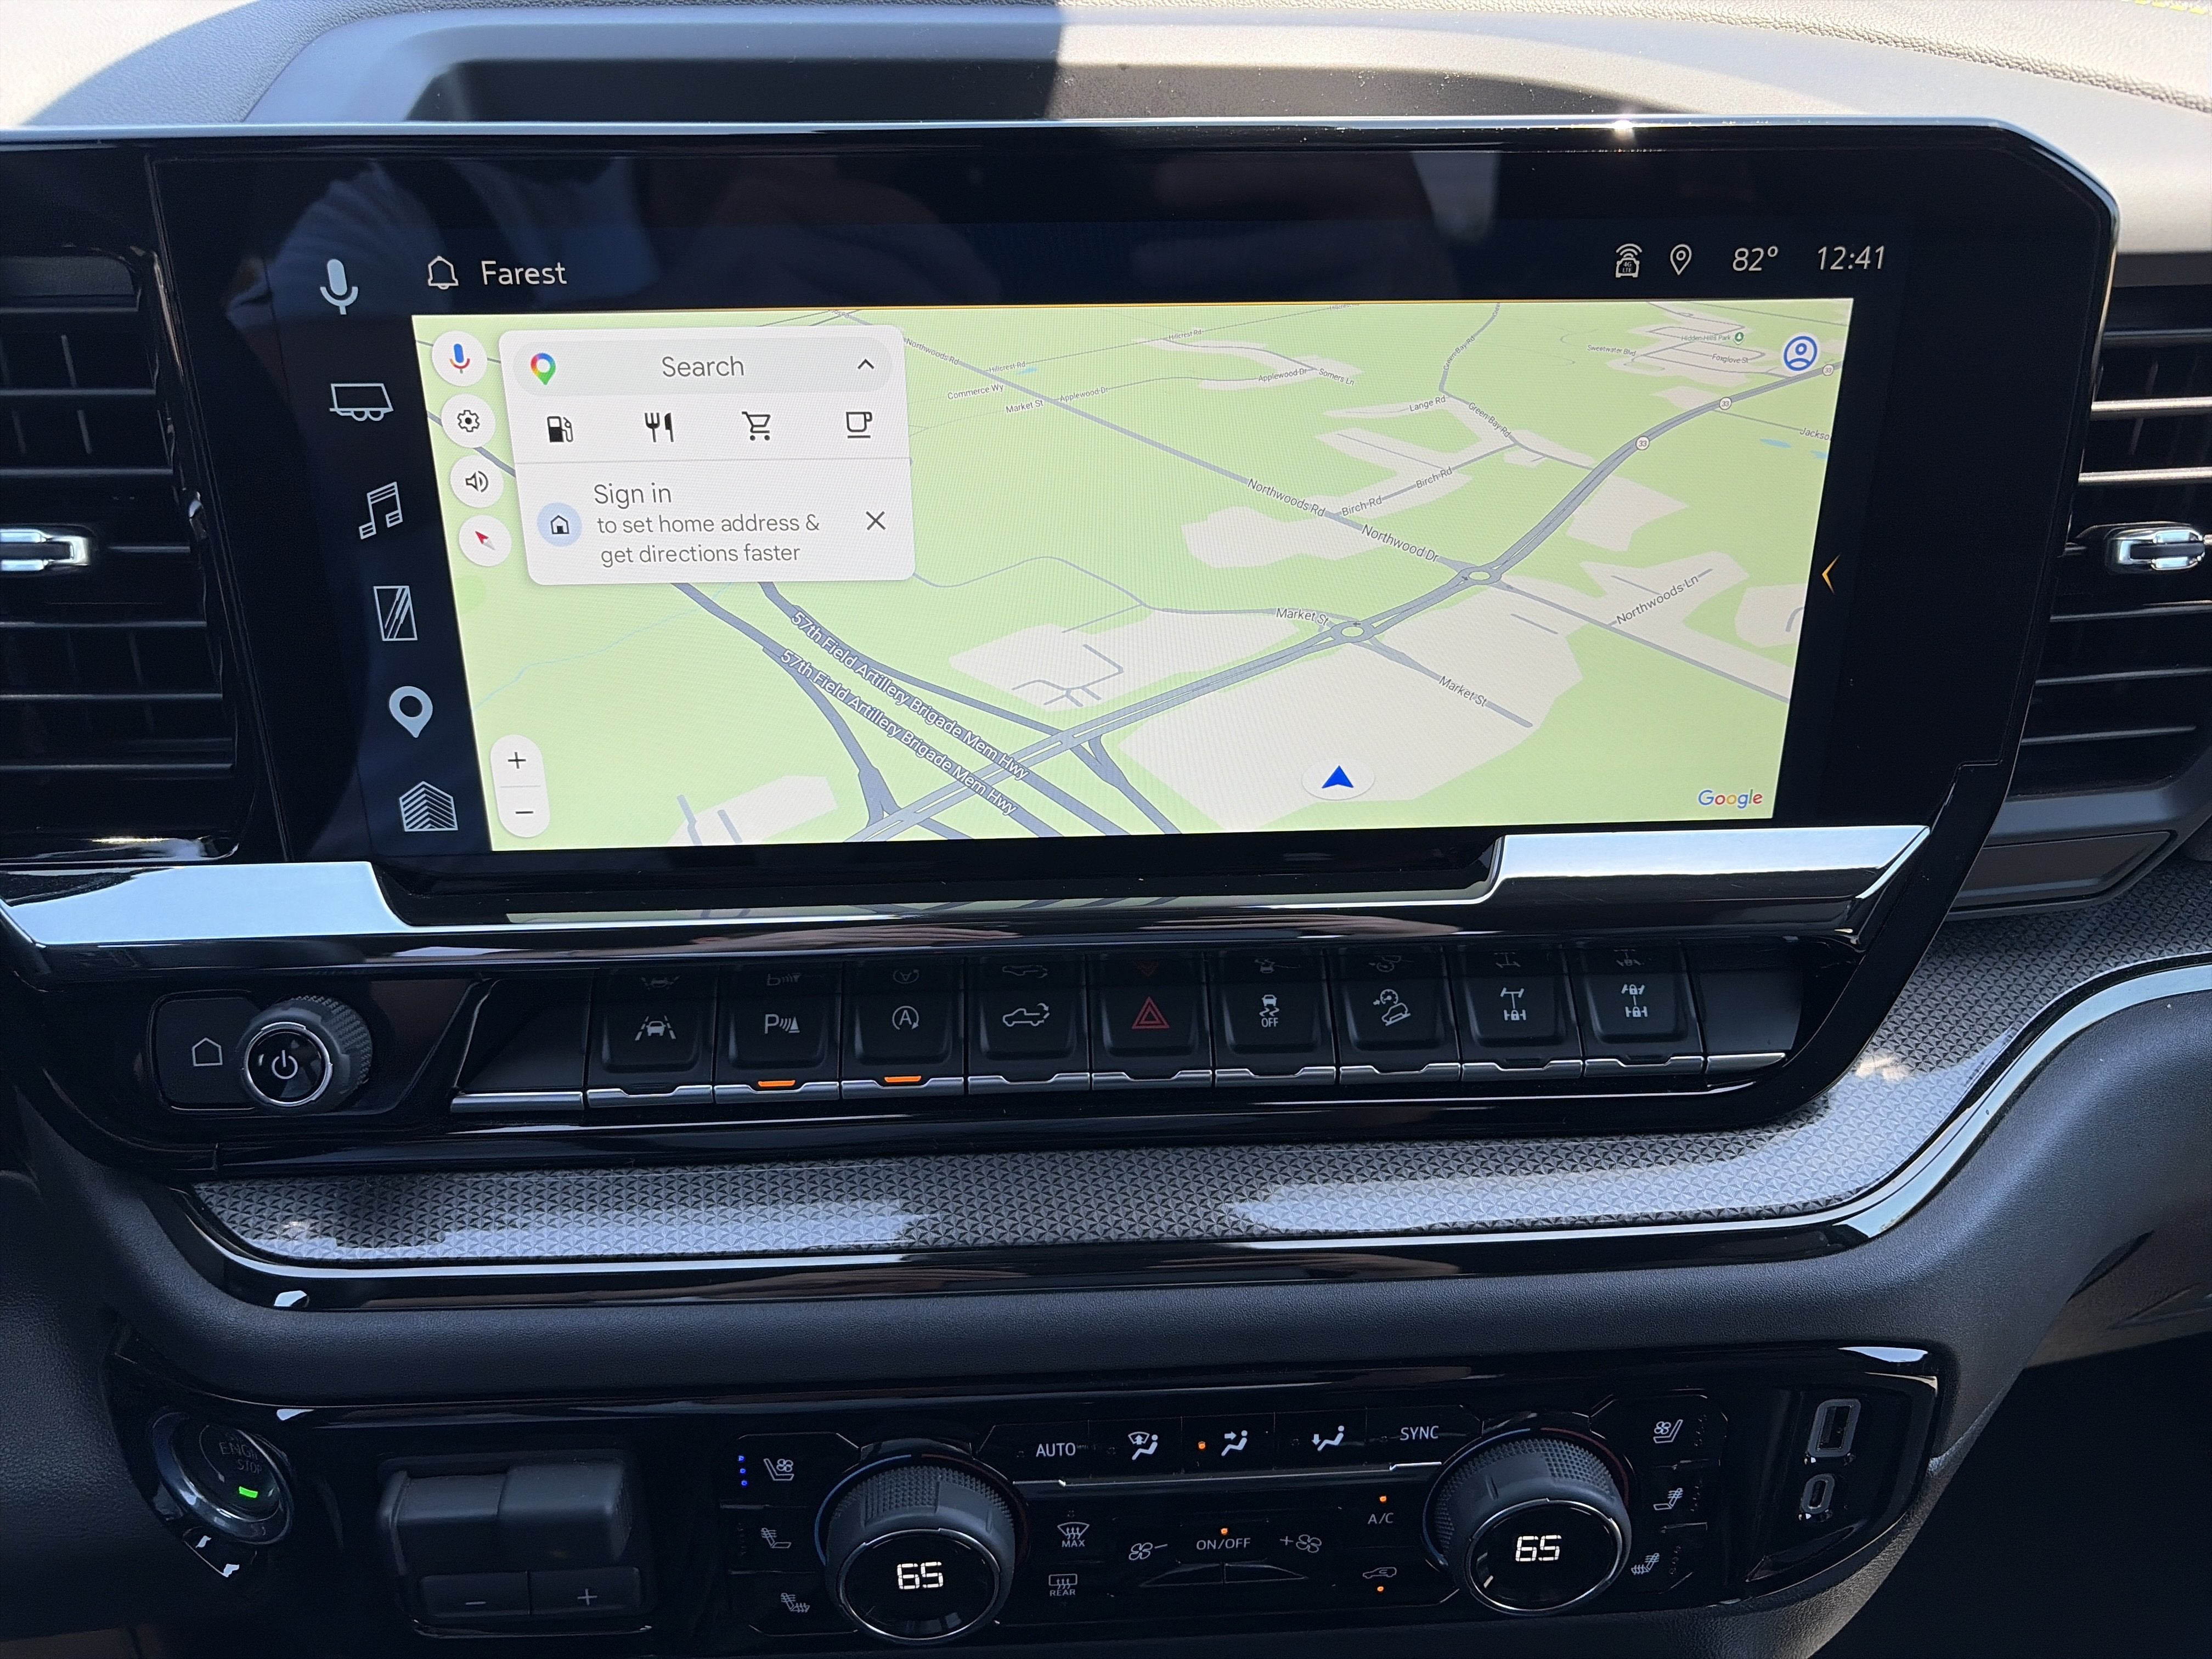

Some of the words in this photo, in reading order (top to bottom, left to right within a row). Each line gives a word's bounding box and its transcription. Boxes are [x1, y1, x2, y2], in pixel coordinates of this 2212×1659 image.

[1817, 245, 1885, 270] 12:41
[481, 261, 567, 285] Farest
[1169, 330, 1193, 340] Hillcrest
[906, 338, 950, 362] Northwoods
[949, 355, 960, 365] Rd
[1443, 352, 1456, 370] Green
[1455, 342, 1468, 354] Bay
[1466, 335, 1475, 345] Rd
[1587, 345, 1623, 354] Sweetwater
[1623, 348, 1637, 357] Blvd
[1712, 353, 1740, 364] Foxglove
[662, 356, 744, 377] Search
[988, 362, 1016, 374] Hillcrest
[1017, 360, 1026, 369] Rd
[1258, 370, 1298, 382] Applewood
[1318, 368, 1345, 382] Somers
[1345, 377, 1355, 386] Ln
[947, 386, 990, 400] Commerce
[990, 383, 1004, 395] Wy
[1059, 387, 1099, 403] Applewood
[1100, 386, 1109, 394] Dr
[1006, 401, 1034, 414] Market
[1035, 399, 1043, 408] St
[1409, 399, 1434, 412] Lange
[1435, 396, 1446, 404] Rd
[1468, 402, 1488, 420] Green
[1488, 415, 1502, 430] Bay
[1500, 426, 1511, 438] Rd
[1799, 427, 1830, 441] Jackso
[1415, 473, 1438, 488] Birch
[1440, 466, 1453, 478] Rd
[594, 483, 645, 509] Sign
[651, 482, 672, 503] in
[1248, 478, 1309, 510] Northwoods
[1310, 503, 1325, 516] Rd
[1342, 499, 1366, 516] Birch
[1368, 496, 1382, 509] Rd
[597, 516, 617, 533] to
[623, 516, 653, 532] set
[659, 514, 714, 532] home
[721, 514, 800, 531] address
[805, 514, 820, 531] &
[1361, 524, 1425, 557] Northwood
[1425, 548, 1440, 562] Dr
[601, 547, 633, 567] get
[639, 544, 738, 563] directions
[743, 543, 800, 562] faster
[1616, 583, 1683, 624] Northwoods
[1684, 574, 1699, 588] Ln
[1276, 608, 1316, 623] Market
[1317, 614, 1329, 625] St
[791, 611, 823, 645] 57th
[821, 636, 856, 668] Field
[856, 663, 911, 706] Artillery
[909, 698, 962, 738] Brigade
[962, 731, 998, 761] Mem
[996, 753, 1029, 781] Hwy
[1439, 675, 1475, 700] Market
[1475, 695, 1487, 707] St
[781, 650, 812, 679] 57th
[812, 670, 850, 701] Field
[849, 697, 902, 738] Artillery
[901, 730, 953, 771] Brigade
[952, 765, 987, 794] Mem
[985, 788, 1018, 816] Hwy
[1699, 789, 1763, 809] Google
[1261, 1017, 1278, 1028] OFF
[1400, 1425, 1439, 1441] SYNC
[1036, 1443, 1076, 1458] AUTO
[237, 1459, 263, 1475] STOP
[1368, 1513, 1394, 1525] A/C
[1062, 1540, 1085, 1548] MAX
[1196, 1538, 1251, 1551] ON/OFF
[1515, 1534, 1562, 1562] 65
[897, 1561, 943, 1590] 65
